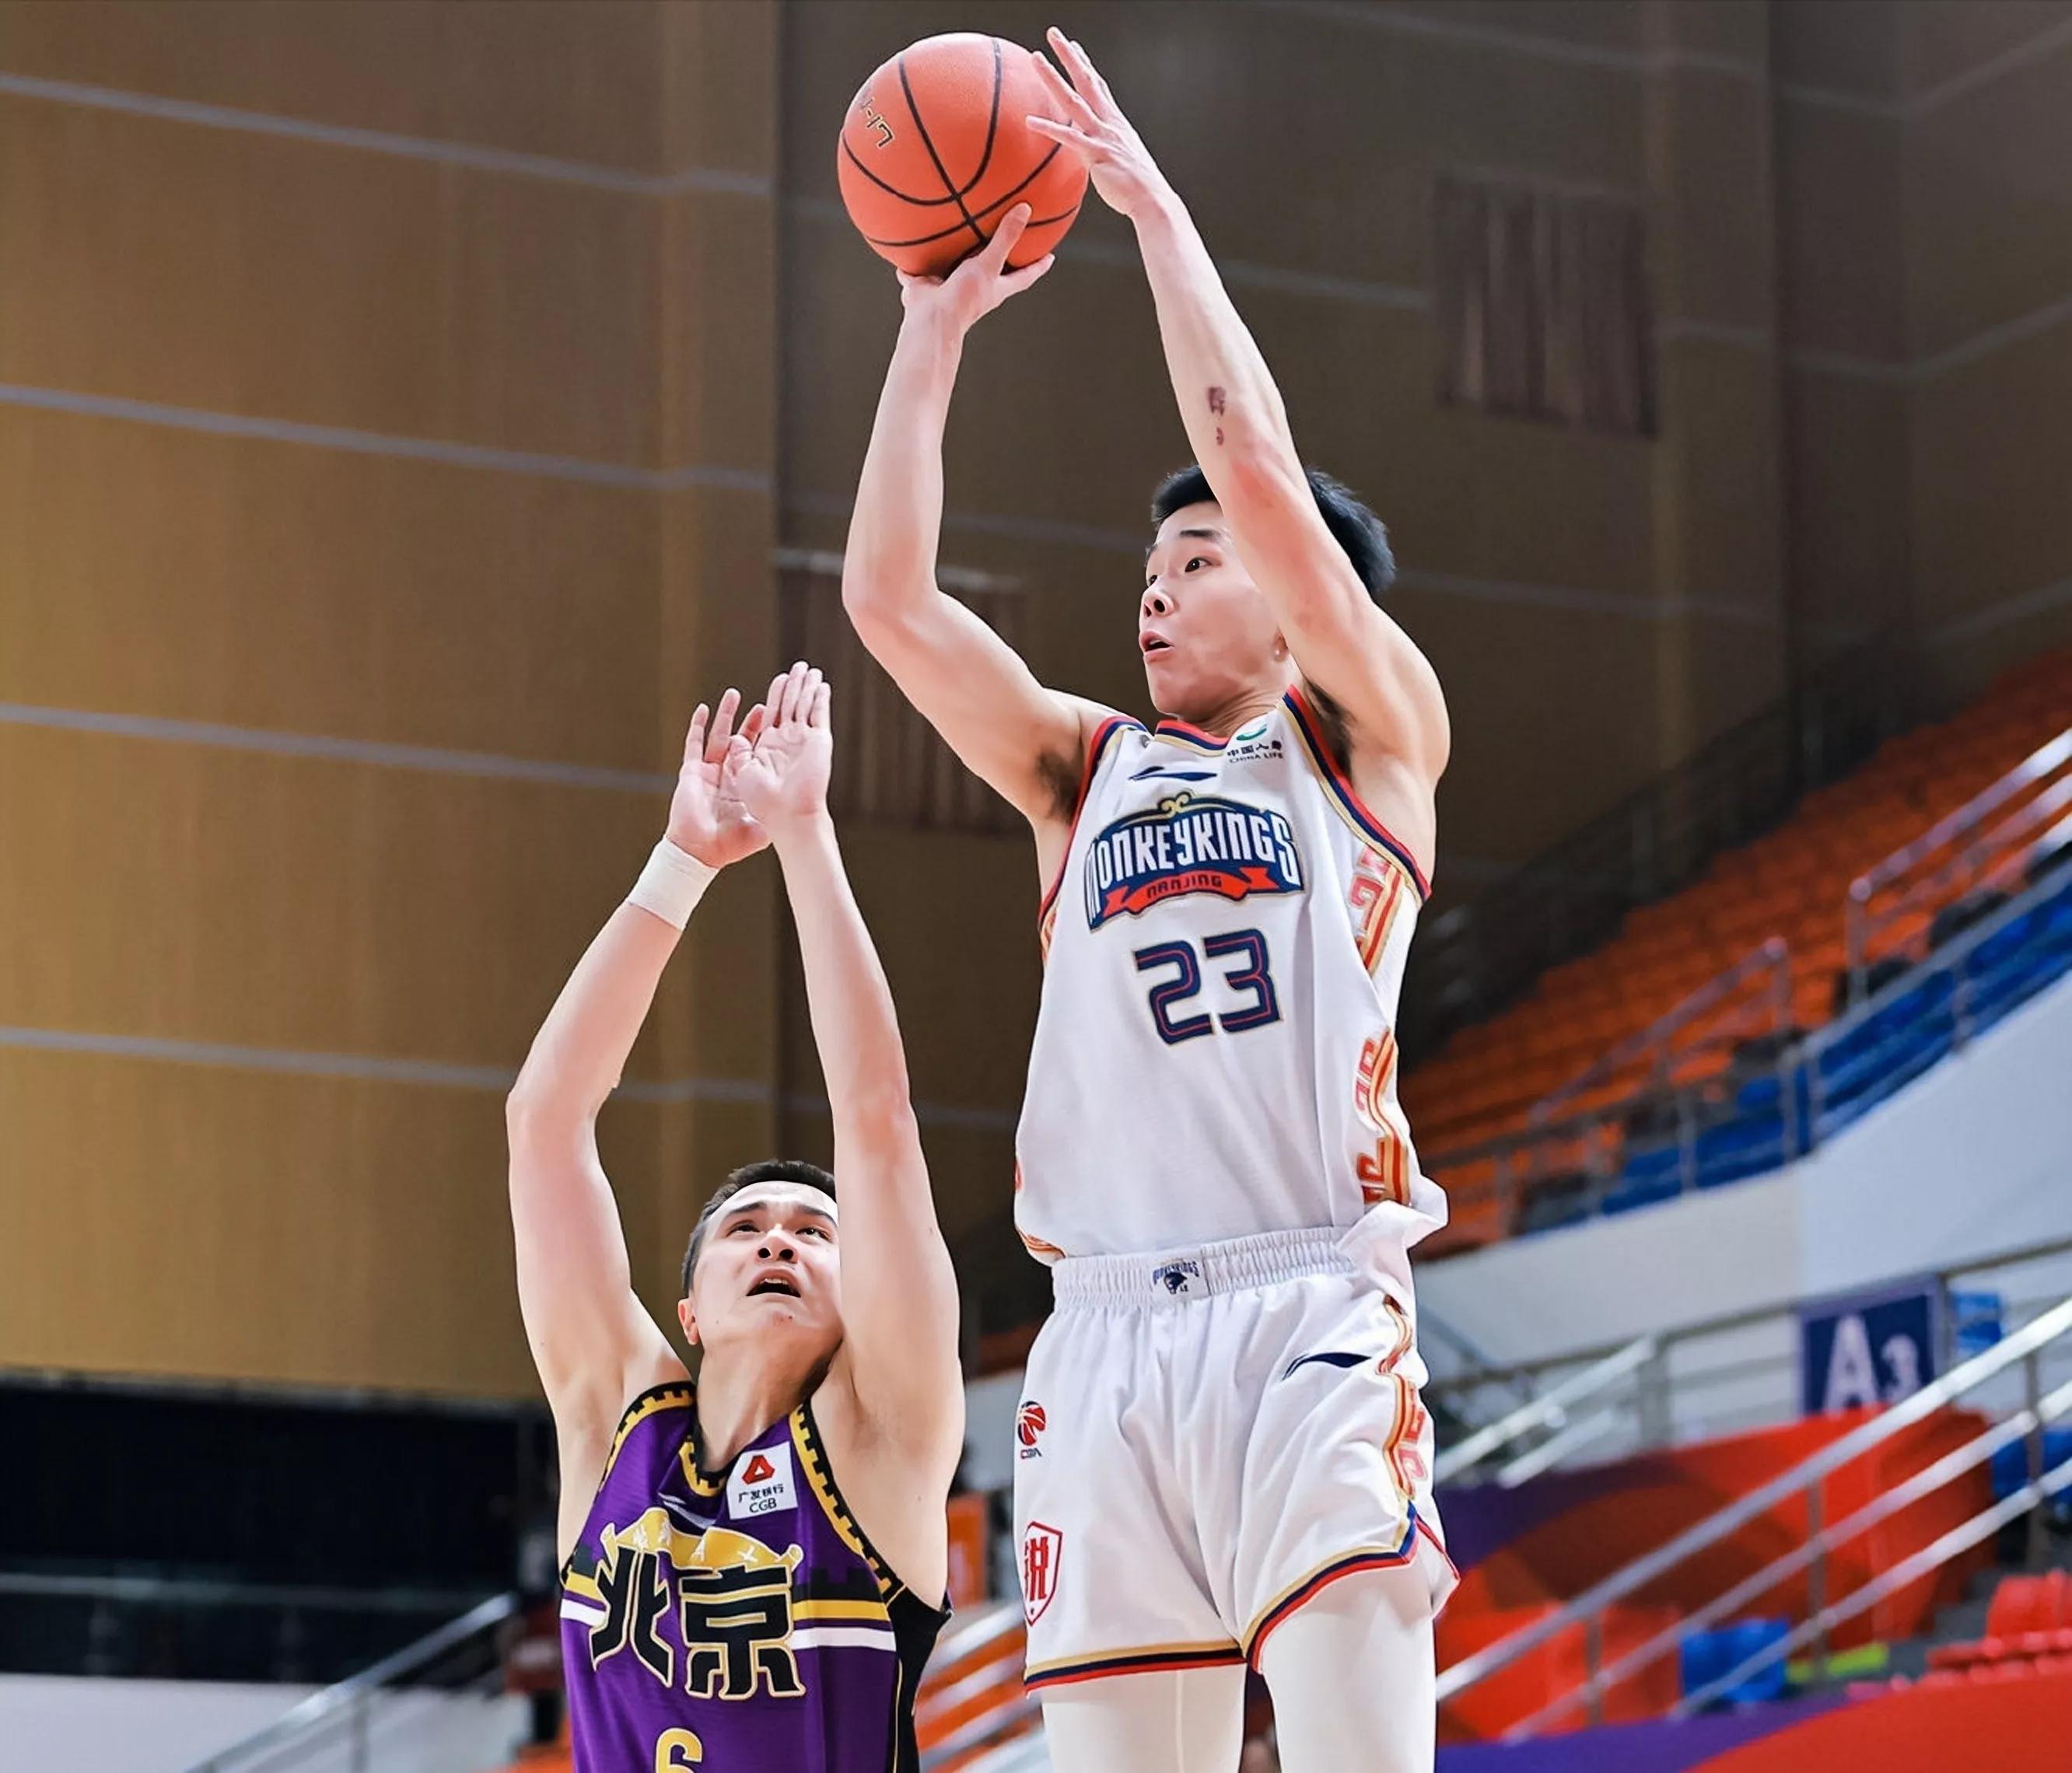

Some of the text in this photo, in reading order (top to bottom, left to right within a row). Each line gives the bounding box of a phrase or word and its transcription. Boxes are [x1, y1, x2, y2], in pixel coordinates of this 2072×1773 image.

[1087, 811, 1301, 925] MONKEYKINGS
[1146, 875, 1223, 899] NANJING
[1134, 928, 1282, 1045] 23
[749, 1498, 778, 1513] CGB
[590, 1544, 806, 1700] 北京
